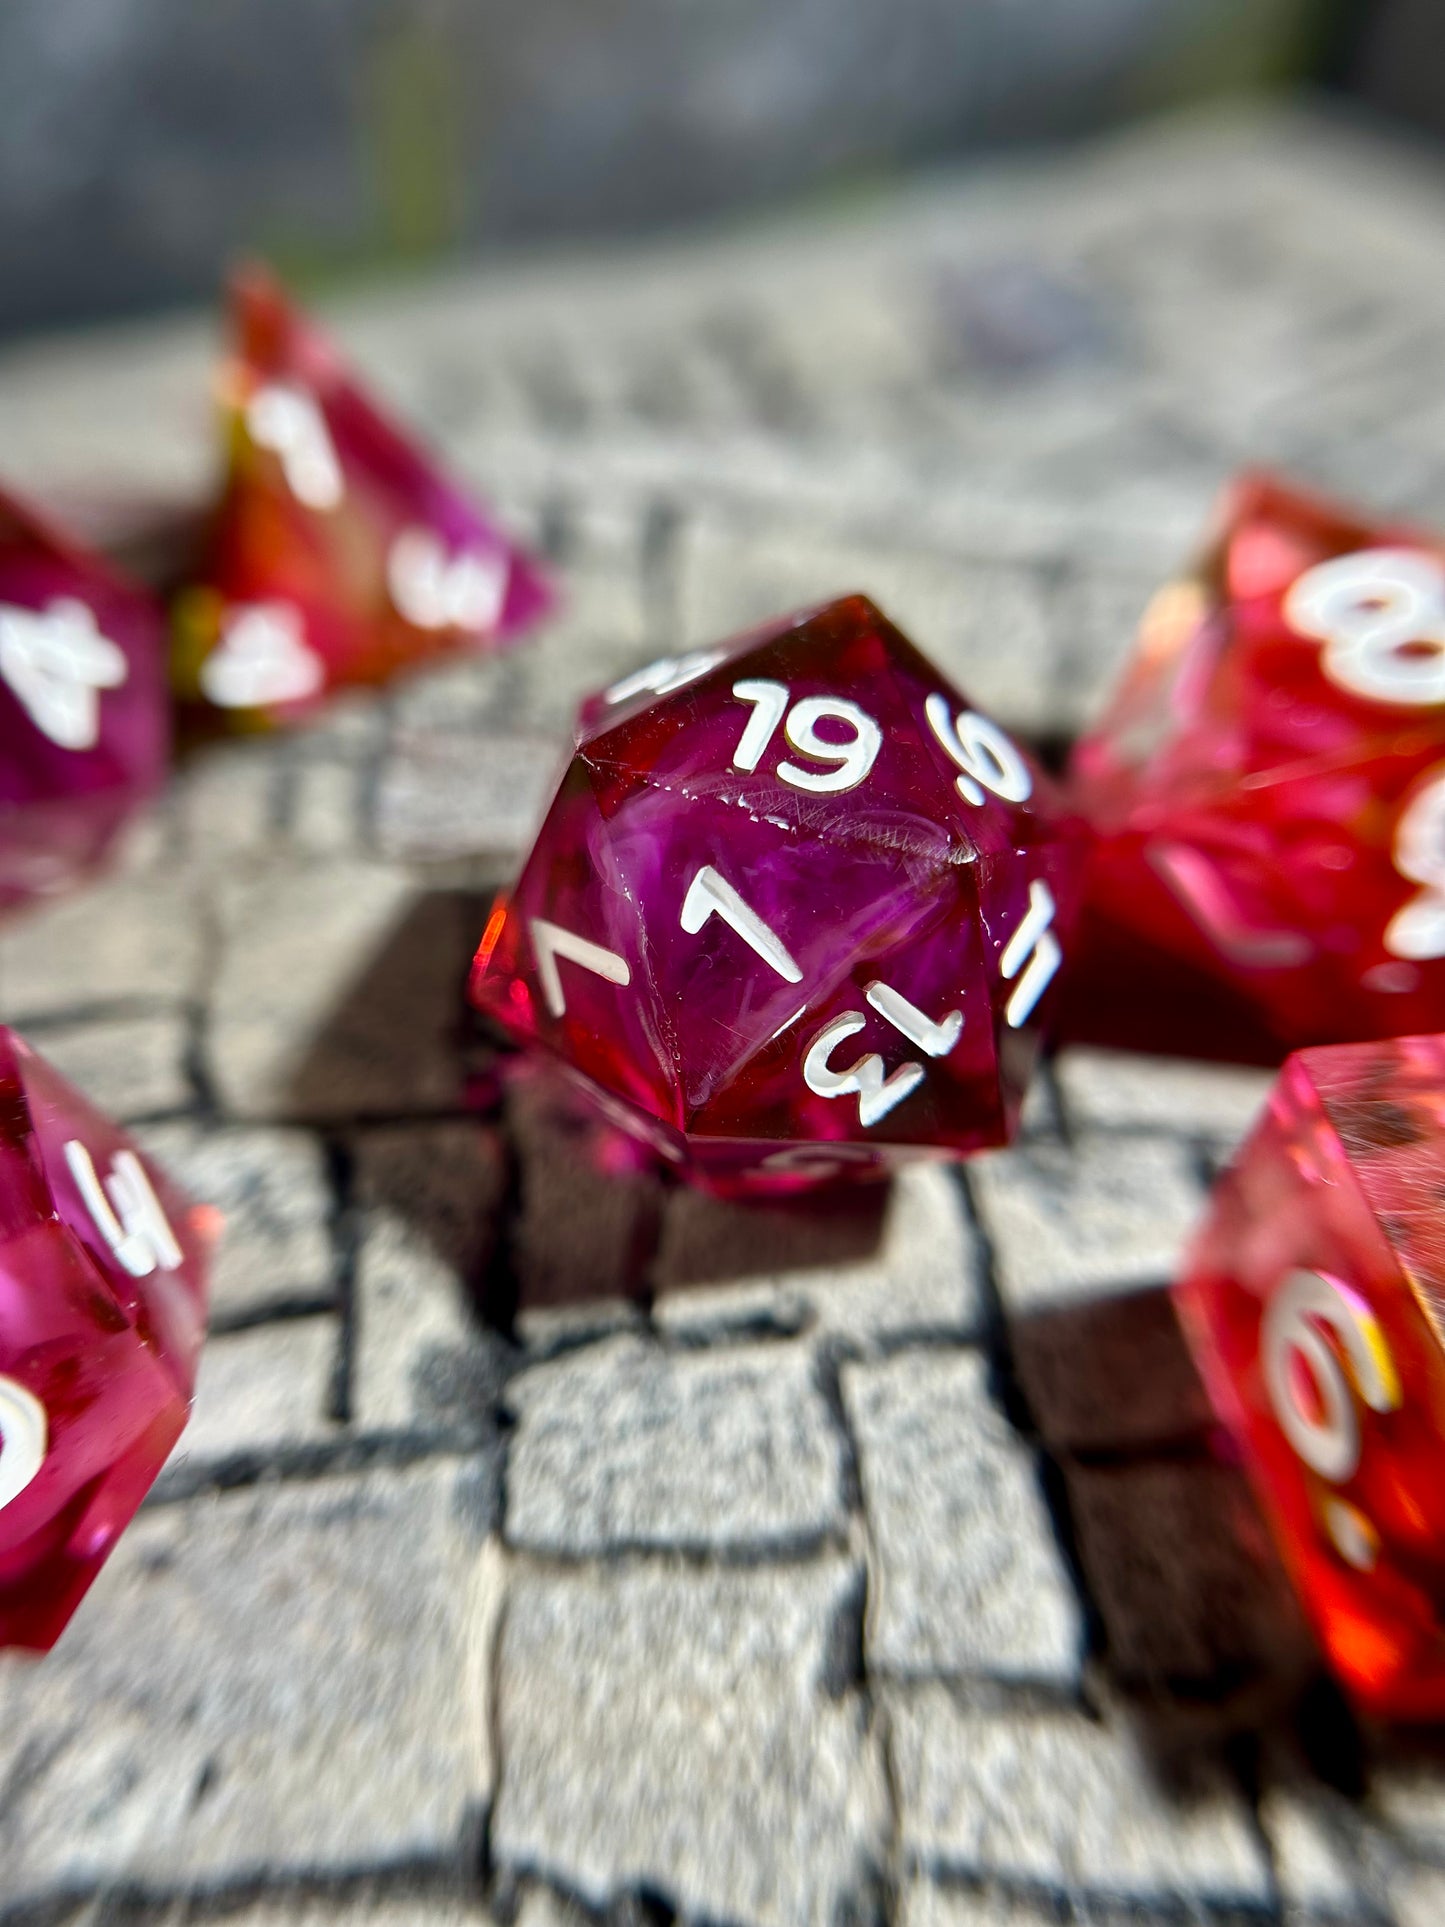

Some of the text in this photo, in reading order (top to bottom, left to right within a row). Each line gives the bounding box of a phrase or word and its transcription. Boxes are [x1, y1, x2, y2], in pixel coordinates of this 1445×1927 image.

[732, 679, 883, 794] 19
[680, 864, 804, 984] 1
[802, 979, 964, 1128] 13
